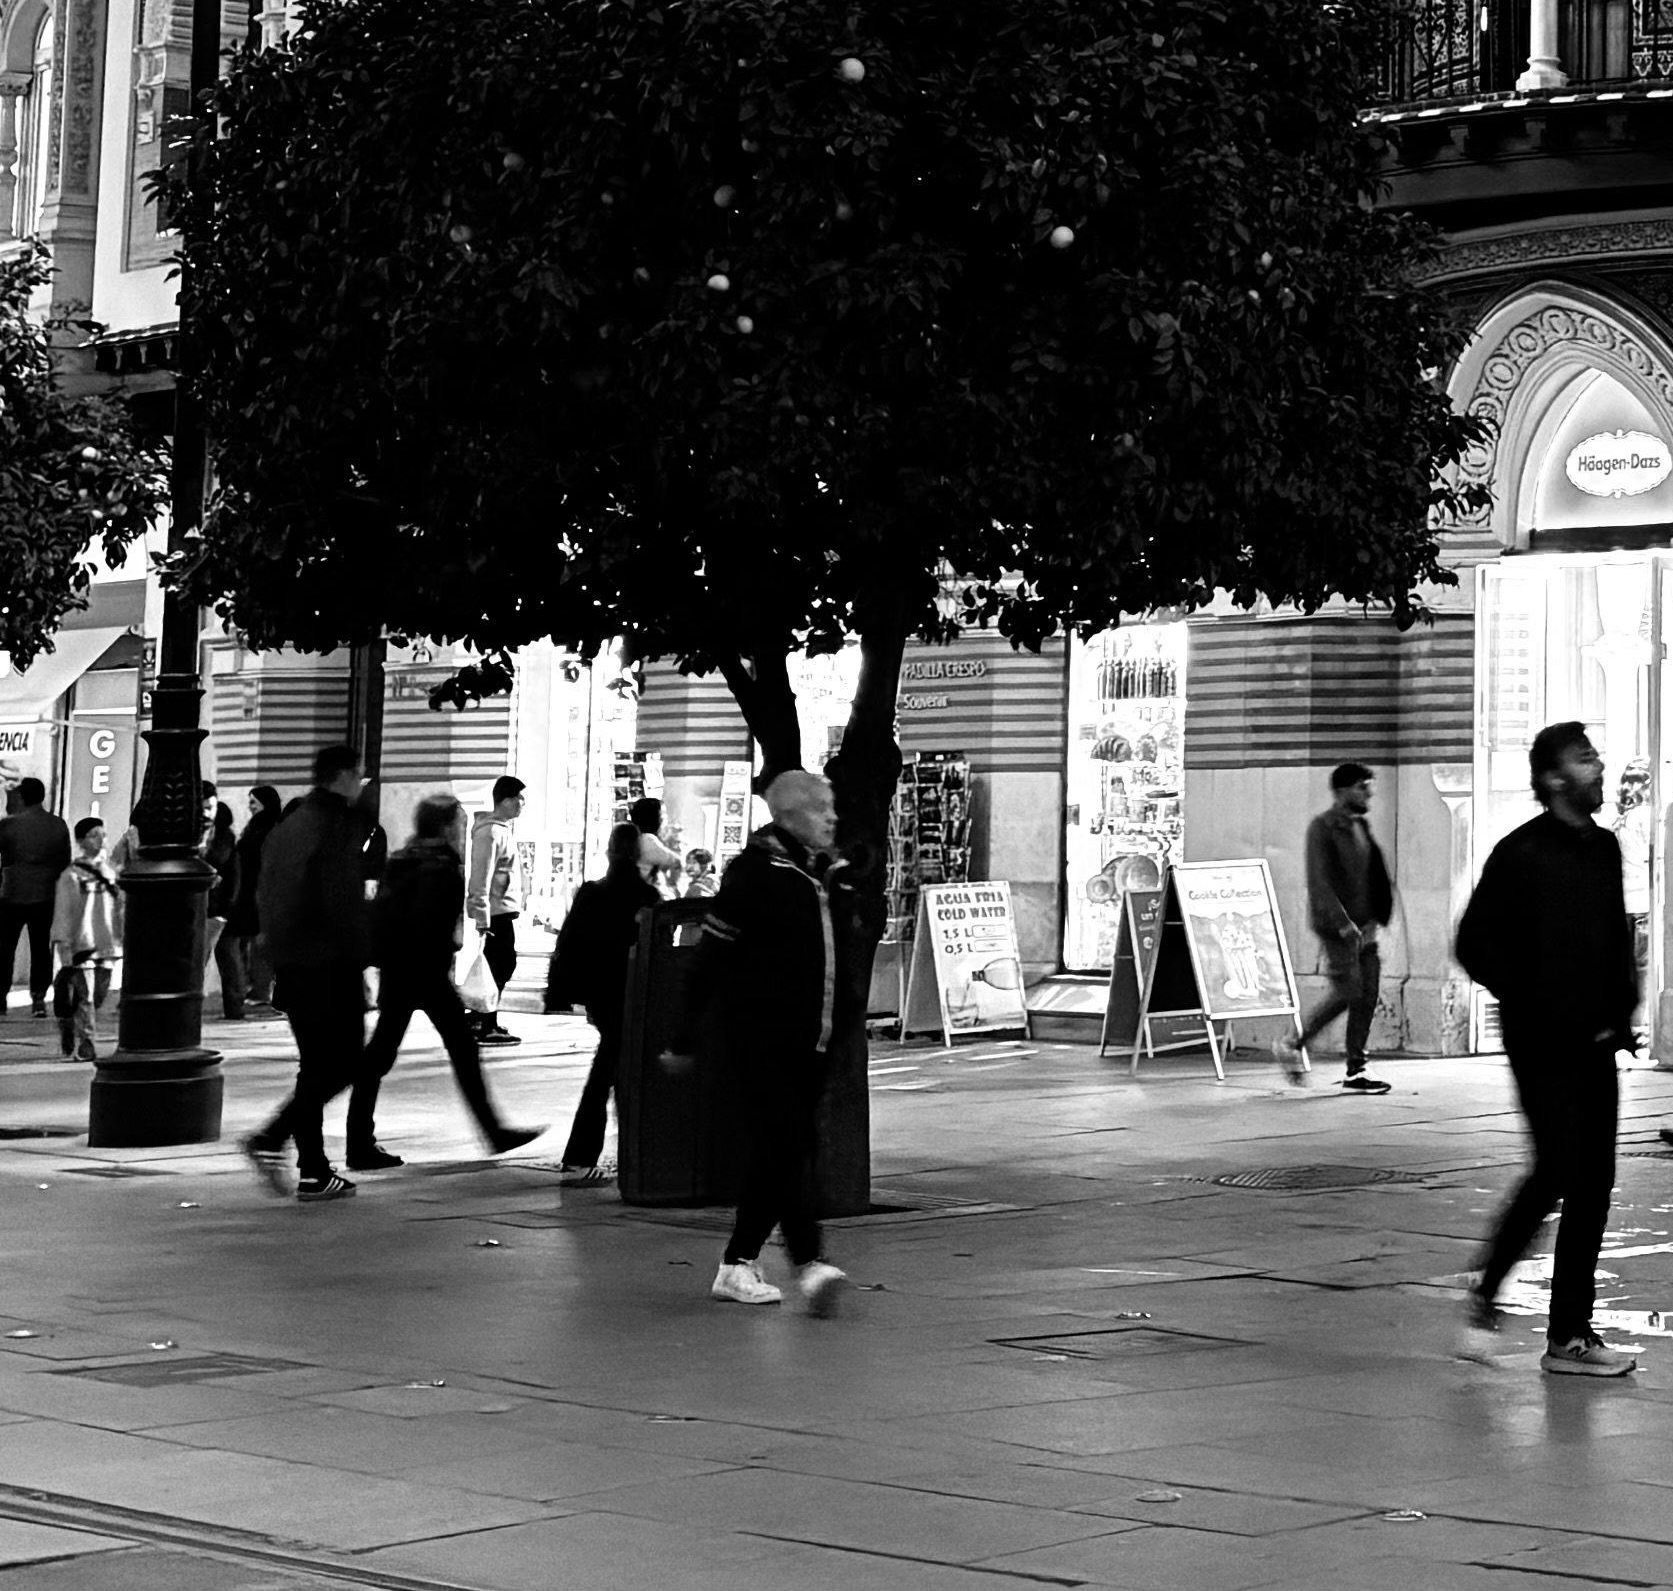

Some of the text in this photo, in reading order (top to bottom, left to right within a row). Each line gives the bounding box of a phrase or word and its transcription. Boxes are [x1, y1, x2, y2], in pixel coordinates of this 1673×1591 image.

[935, 893, 971, 906] AGUA
[937, 906, 1006, 921] COLD WATER
